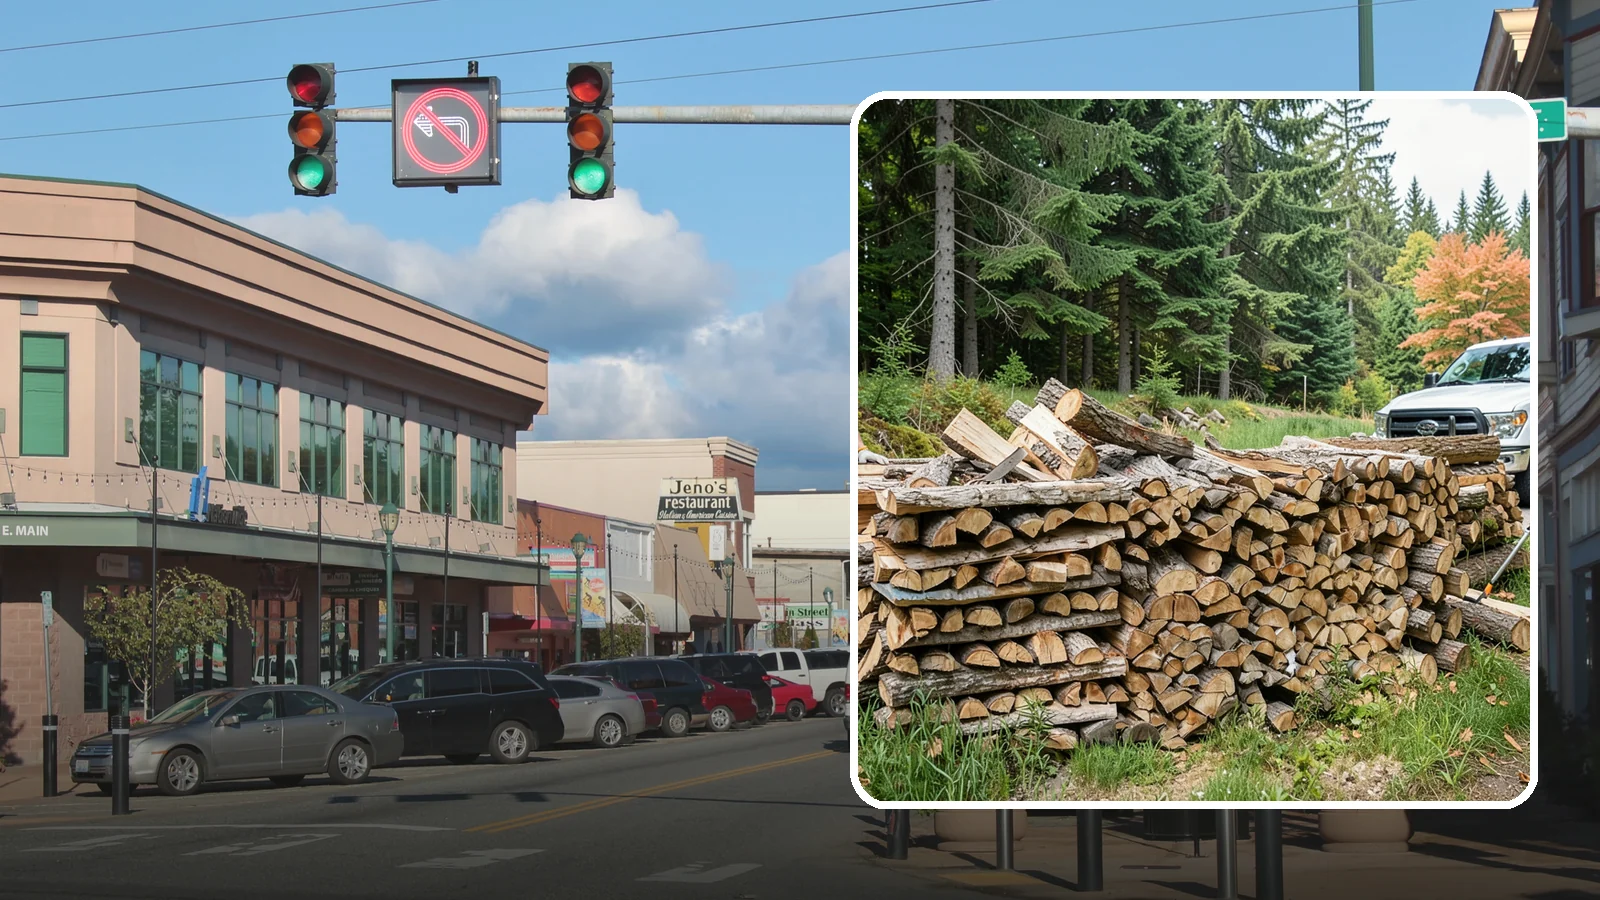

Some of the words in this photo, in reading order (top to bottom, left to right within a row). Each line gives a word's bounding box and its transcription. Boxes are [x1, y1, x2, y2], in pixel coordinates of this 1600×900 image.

[670, 480, 728, 494] Jeno's
[665, 496, 731, 509] restaurant
[659, 510, 681, 519] Italian
[686, 510, 714, 519] American
[715, 509, 737, 519] Cuisine
[2, 525, 13, 536] E.
[15, 525, 49, 536] MAIN
[797, 607, 828, 617] Street
